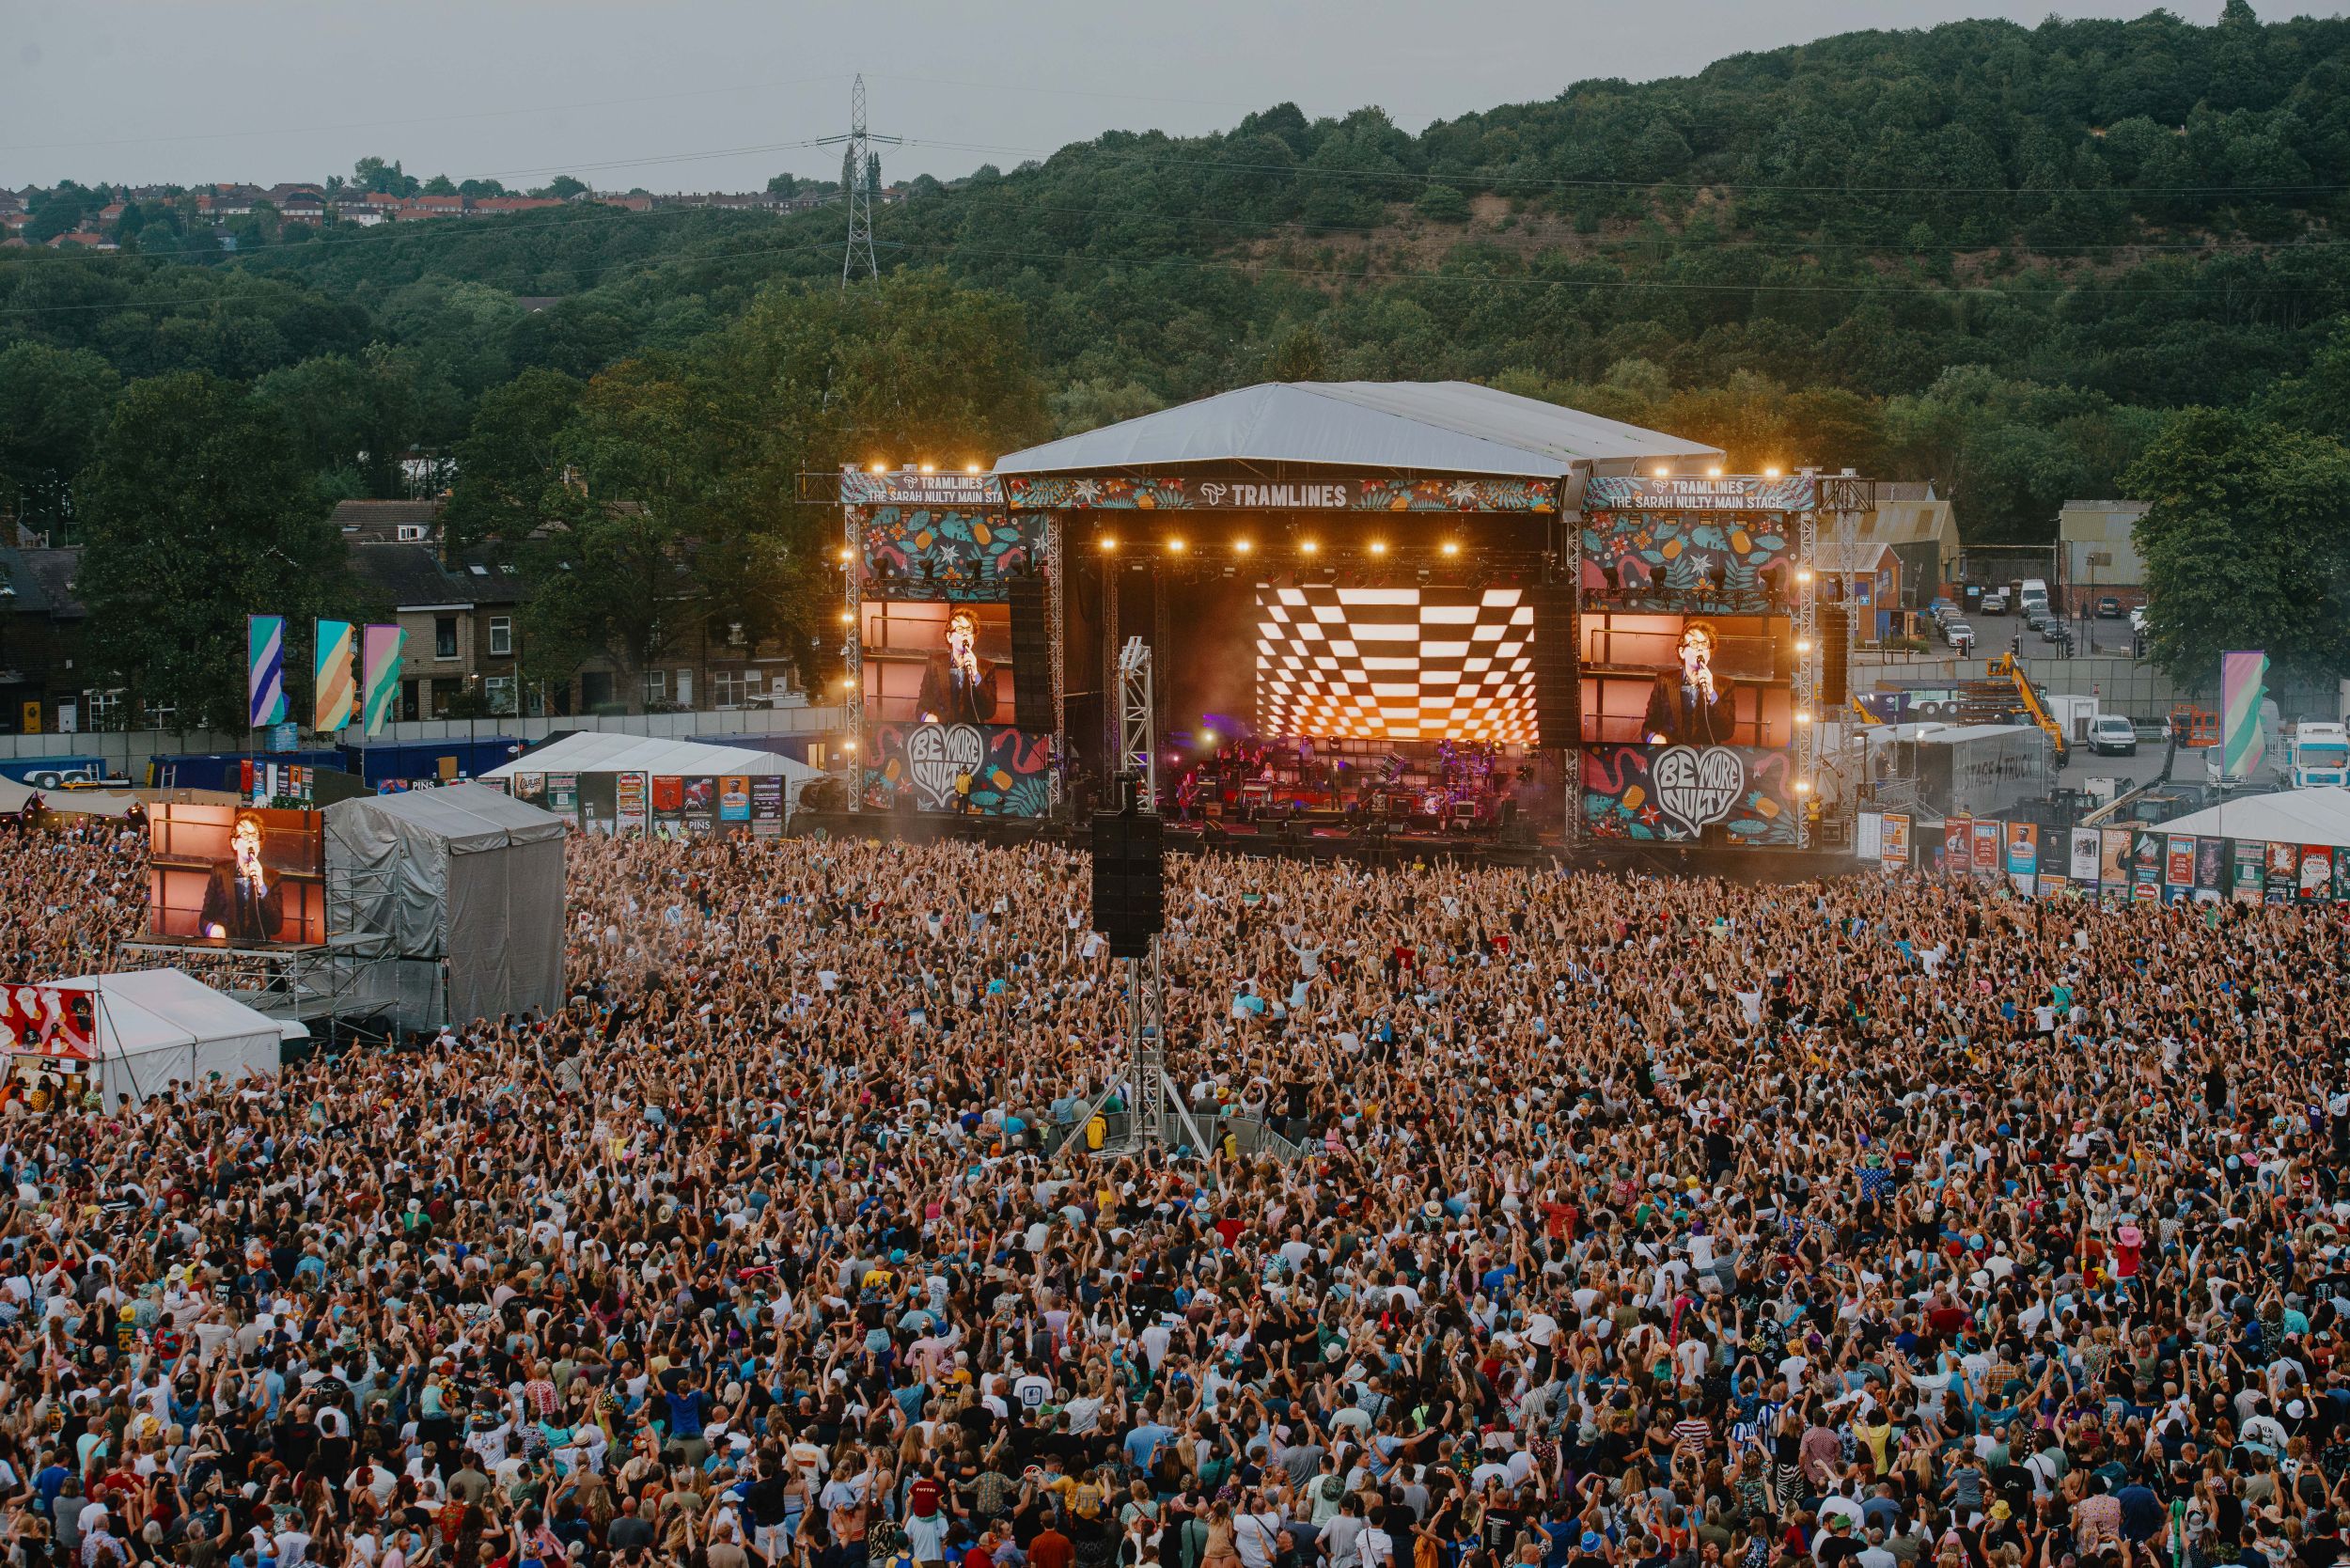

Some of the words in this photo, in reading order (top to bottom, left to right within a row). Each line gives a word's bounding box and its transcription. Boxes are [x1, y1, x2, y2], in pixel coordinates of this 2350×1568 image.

[921, 477, 983, 490] TRAMLINES
[1671, 480, 1744, 494] TRAMLINES
[869, 490, 887, 502] THE
[890, 491, 922, 503] SARAH
[925, 491, 956, 503] NULTY
[958, 491, 982, 503] MAIN
[1231, 484, 1347, 508] TRAMLINES
[1609, 495, 1632, 509] THE
[1635, 495, 1673, 510] SARAH
[1676, 495, 1713, 510] NULTY
[1716, 495, 1744, 510] MAIN
[1747, 495, 1783, 510] STAGE
[913, 729, 943, 760] BE
[946, 728, 979, 763] MORE
[1660, 752, 1696, 787] BE
[1699, 752, 1738, 790] MORE
[1966, 760, 1995, 790] STAGE
[2004, 753, 2032, 782] TRUCK
[413, 781, 435, 791] PINS
[1662, 789, 1733, 824] NULTY
[689, 821, 711, 830] PINS
[1975, 826, 1996, 838] GIRLS
[2106, 831, 2130, 841] VISTAS
[2170, 844, 2193, 854] GIRLS
[2289, 887, 2295, 898] X
